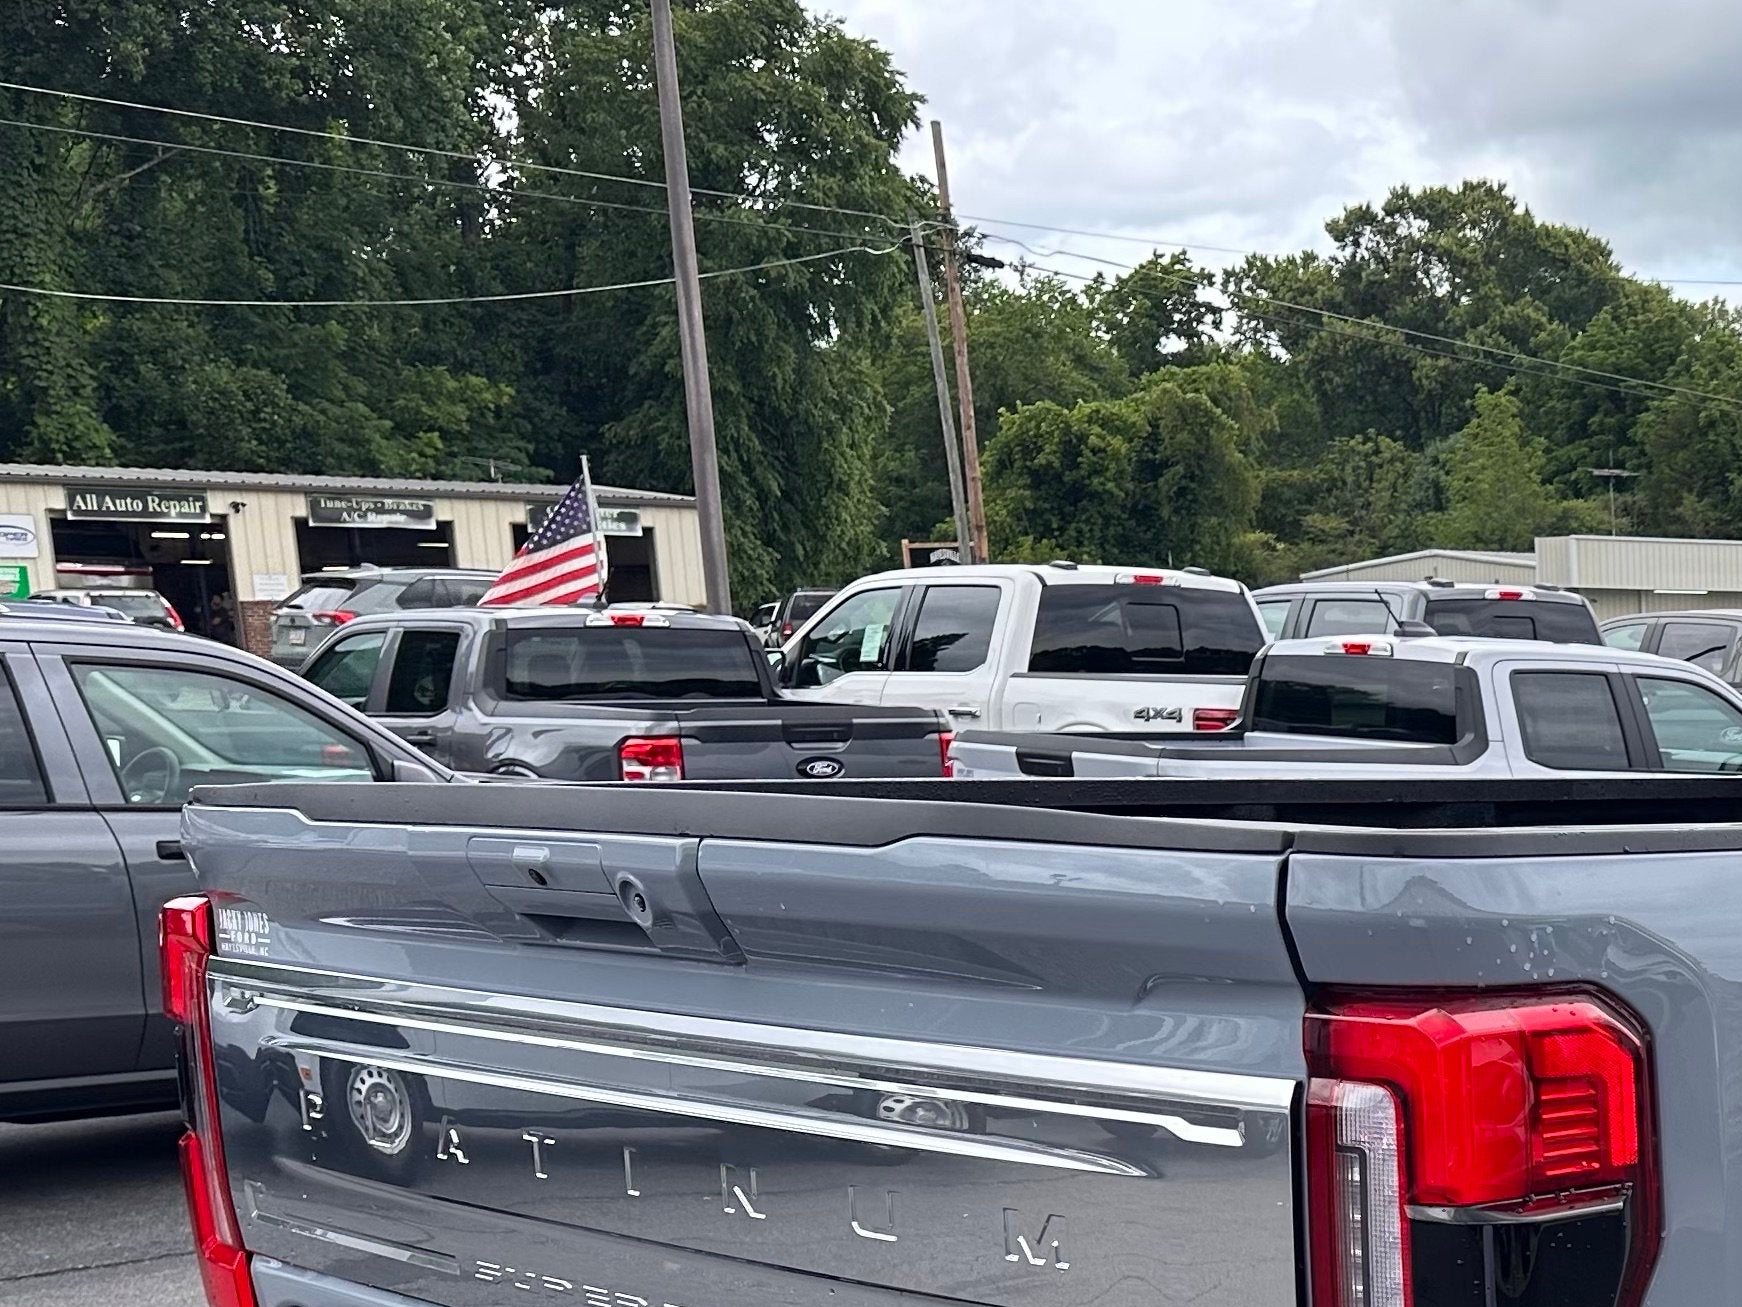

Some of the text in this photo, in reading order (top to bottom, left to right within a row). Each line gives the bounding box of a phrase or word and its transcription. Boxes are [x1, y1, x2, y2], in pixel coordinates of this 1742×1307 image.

[73, 494, 203, 517] All Auto Repair
[340, 511, 364, 523] A/C
[218, 908, 270, 935] JACKY JONES
[230, 930, 257, 945] FORD
[298, 1087, 1071, 1271] PLATINUM
